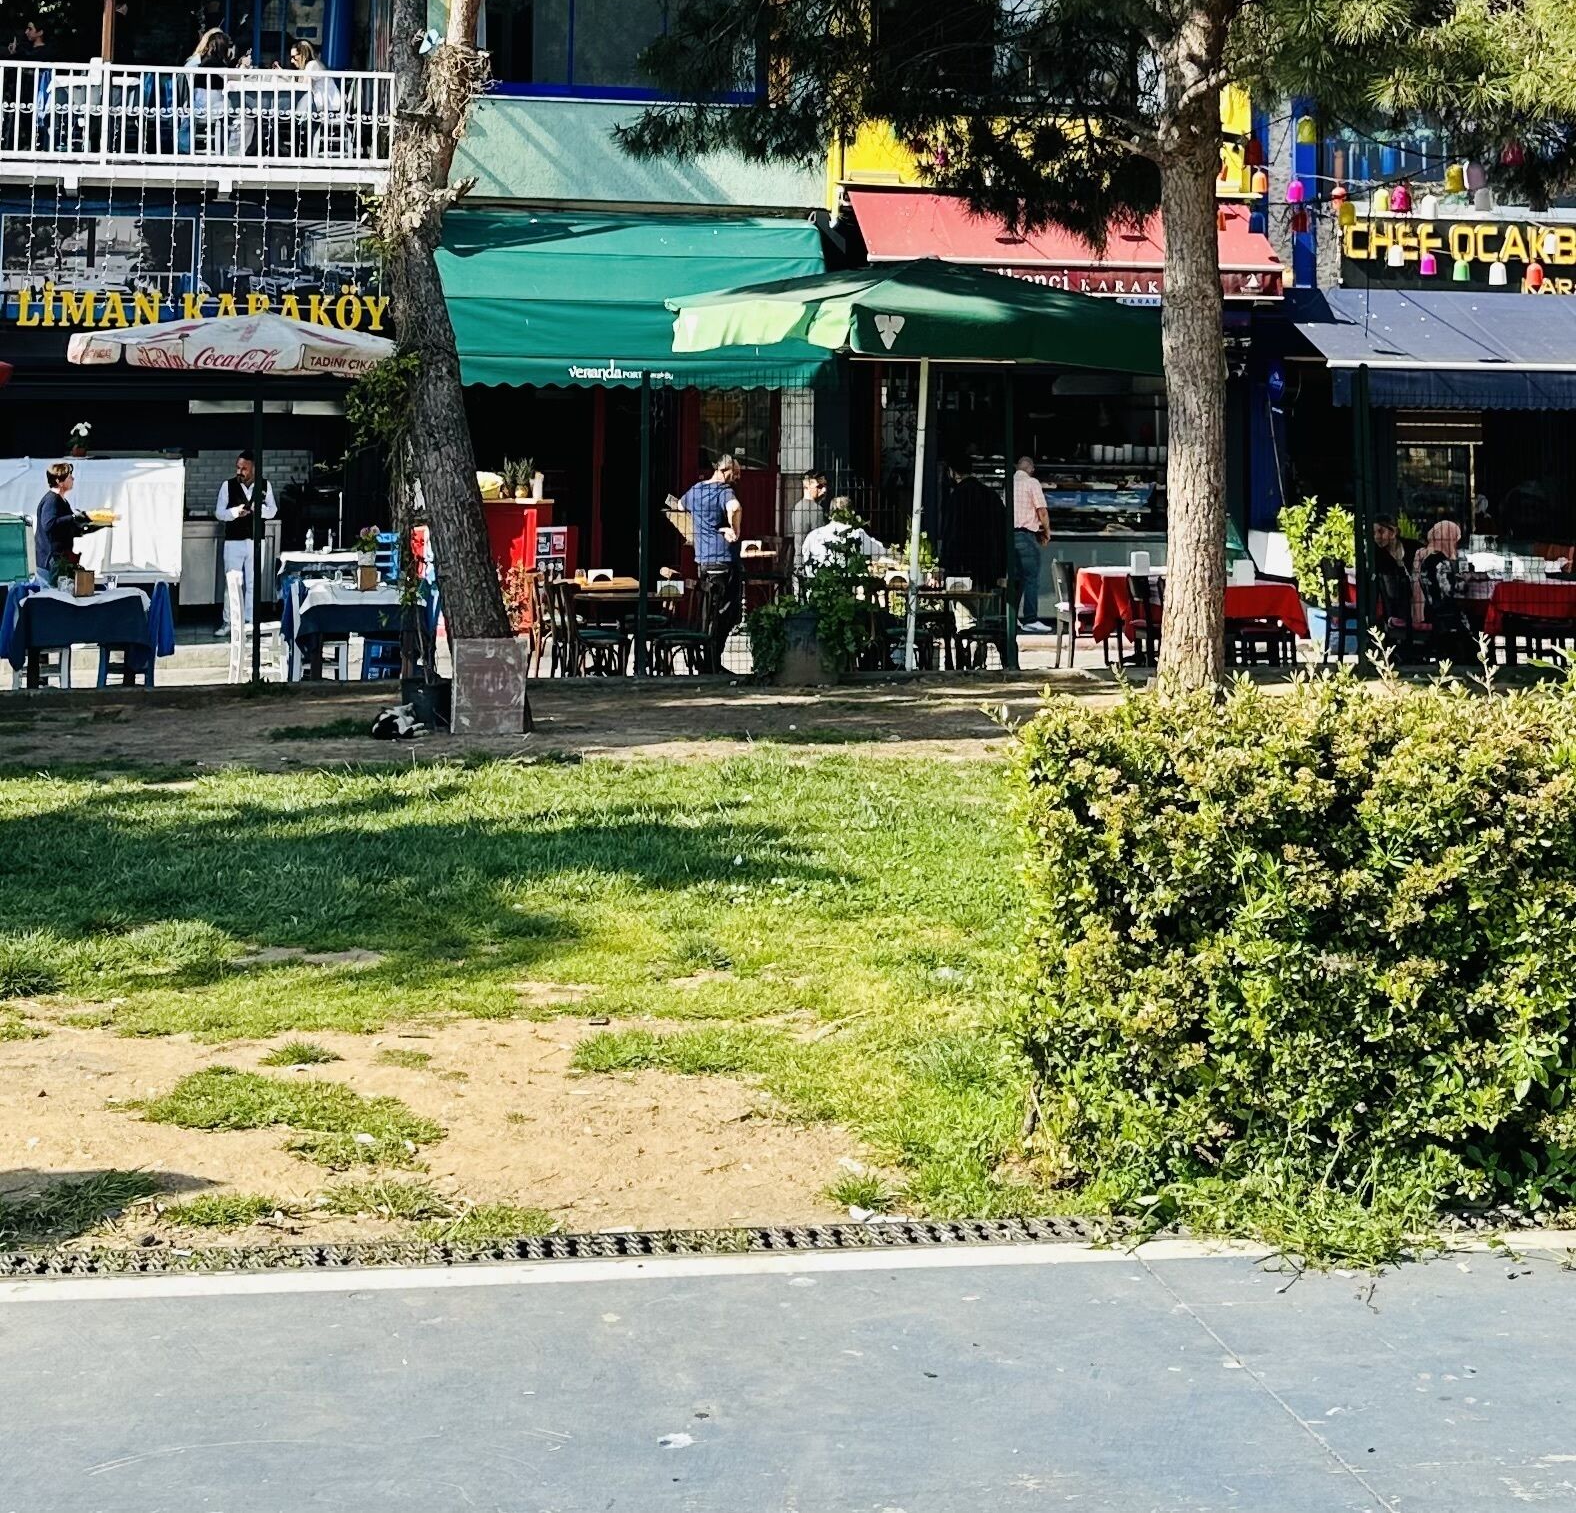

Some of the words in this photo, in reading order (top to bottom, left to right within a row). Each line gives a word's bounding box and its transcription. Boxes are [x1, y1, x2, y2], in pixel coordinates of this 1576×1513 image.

[1344, 222, 1443, 261] CHEF
[1080, 278, 1160, 294] KARAK
[16, 281, 163, 327] LİMAN
[348, 359, 377, 371] ÇIKA
